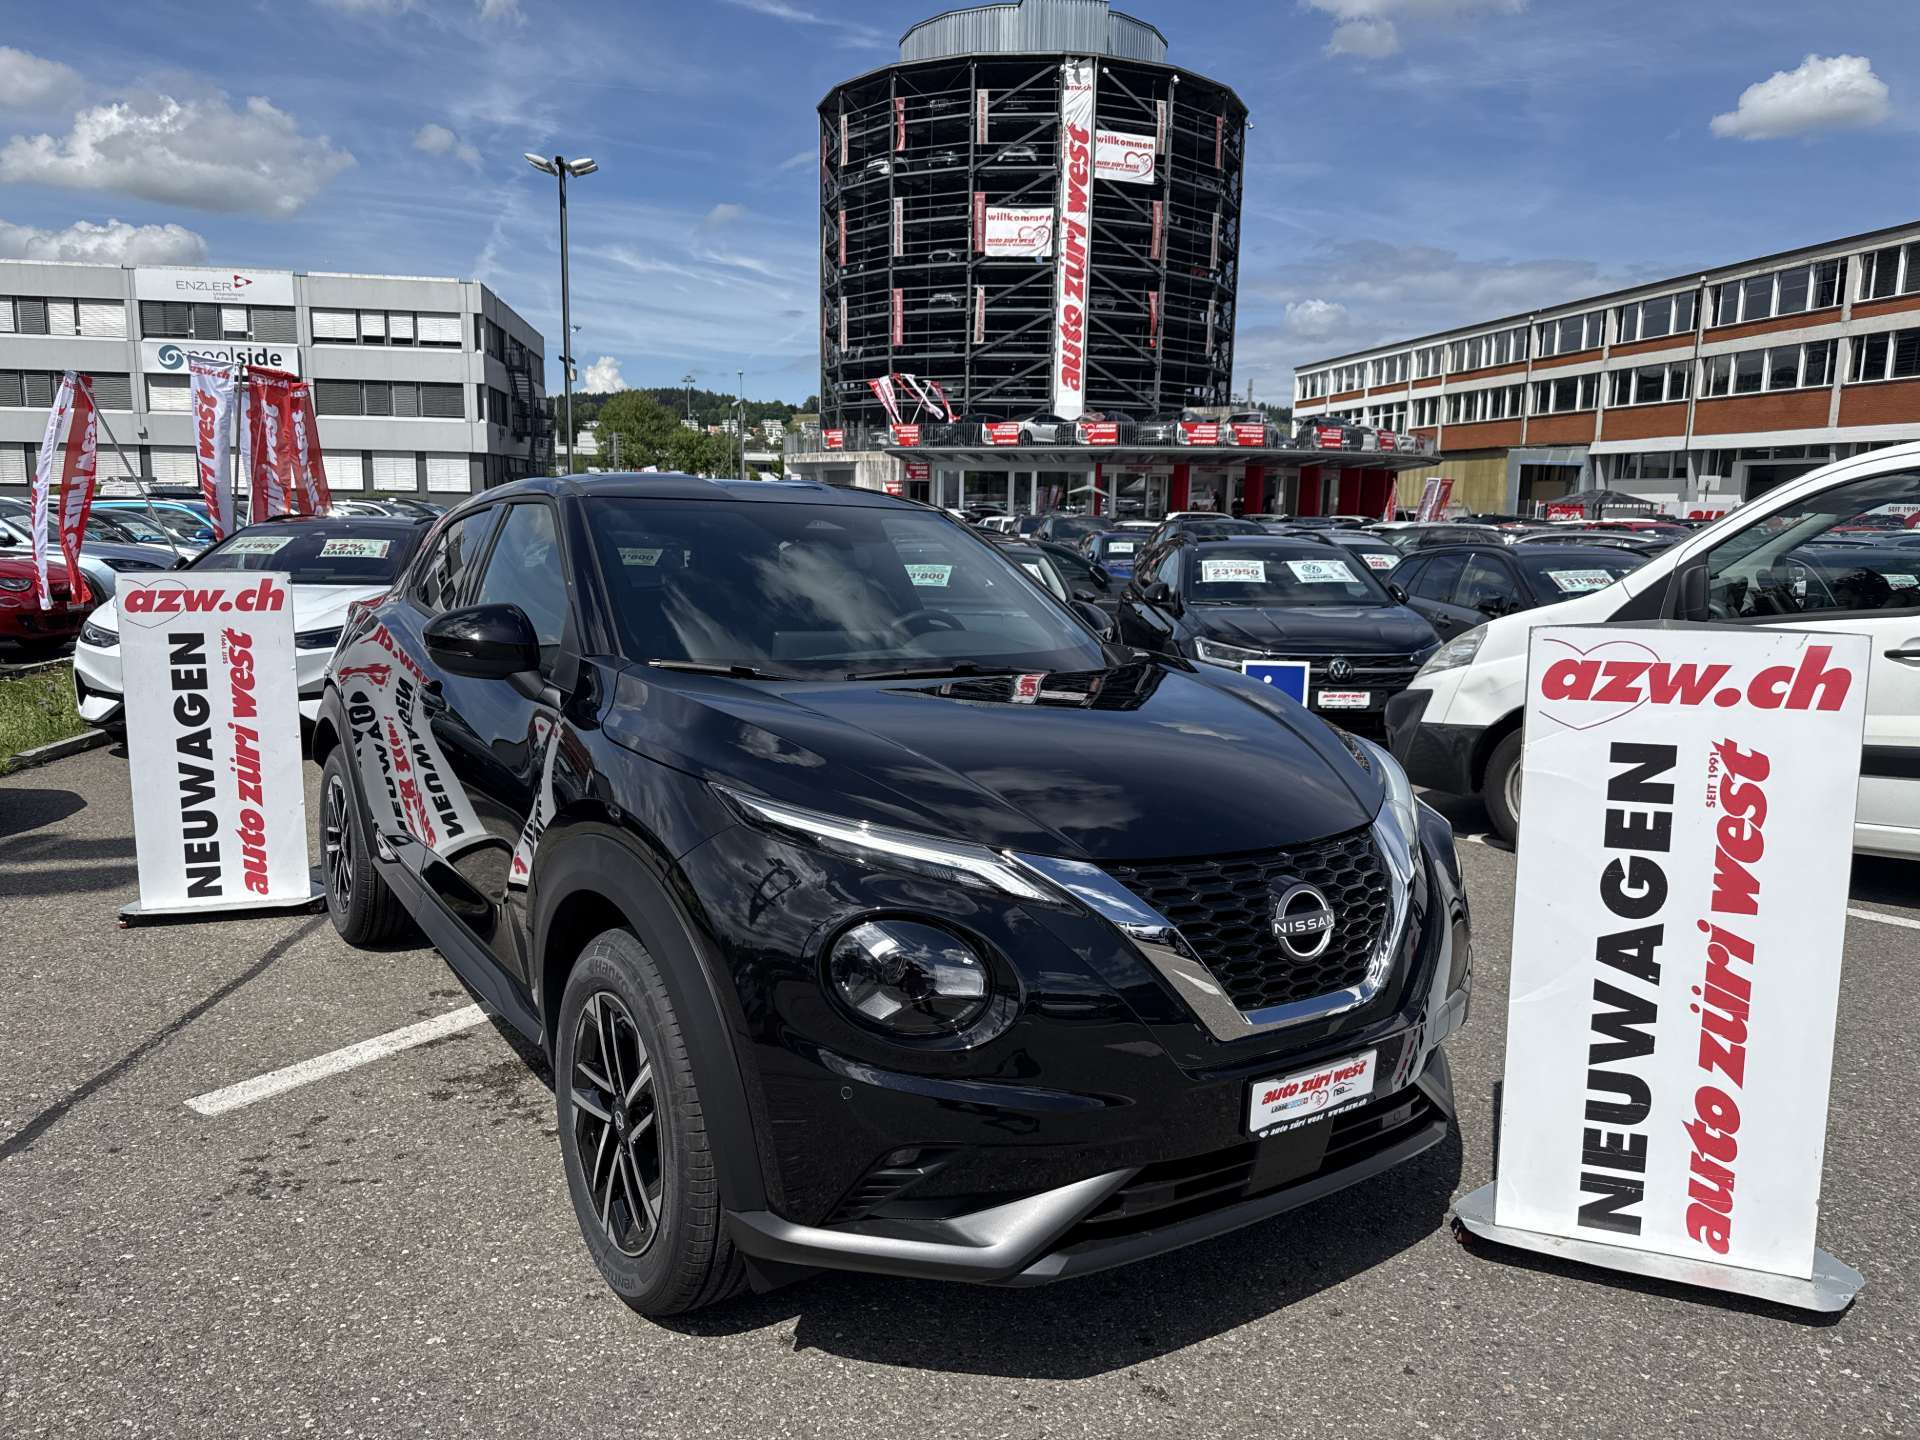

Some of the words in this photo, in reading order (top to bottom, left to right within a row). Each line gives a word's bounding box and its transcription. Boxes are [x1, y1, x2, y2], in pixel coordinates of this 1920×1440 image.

[1067, 122, 1090, 212] west
[1096, 135, 1154, 150] willkommen
[987, 212, 1052, 223] willkommen
[176, 280, 232, 291] ENZLER
[1060, 216, 1087, 303] züri
[1060, 304, 1083, 391] auto
[196, 388, 218, 460] west
[326, 543, 366, 551] 32%
[124, 578, 285, 613] azw.ch
[223, 627, 258, 717] west
[1541, 645, 1854, 712] azw.ch
[168, 632, 222, 898] NEUWAGEN
[227, 722, 263, 808] züri
[1706, 783, 1717, 809] SEIT
[1708, 752, 1720, 779] 1991
[236, 808, 269, 895] auto
[1710, 737, 1771, 916] west
[1274, 912, 1335, 934] NISSAN
[1577, 741, 1678, 1237] NEUWAGEN
[1690, 918, 1758, 1091] züri
[1261, 1082, 1299, 1106] auto
[1299, 1070, 1334, 1094] züri
[1333, 1060, 1368, 1082] west
[1270, 1125, 1289, 1136] auto
[1682, 1087, 1743, 1255] auto
